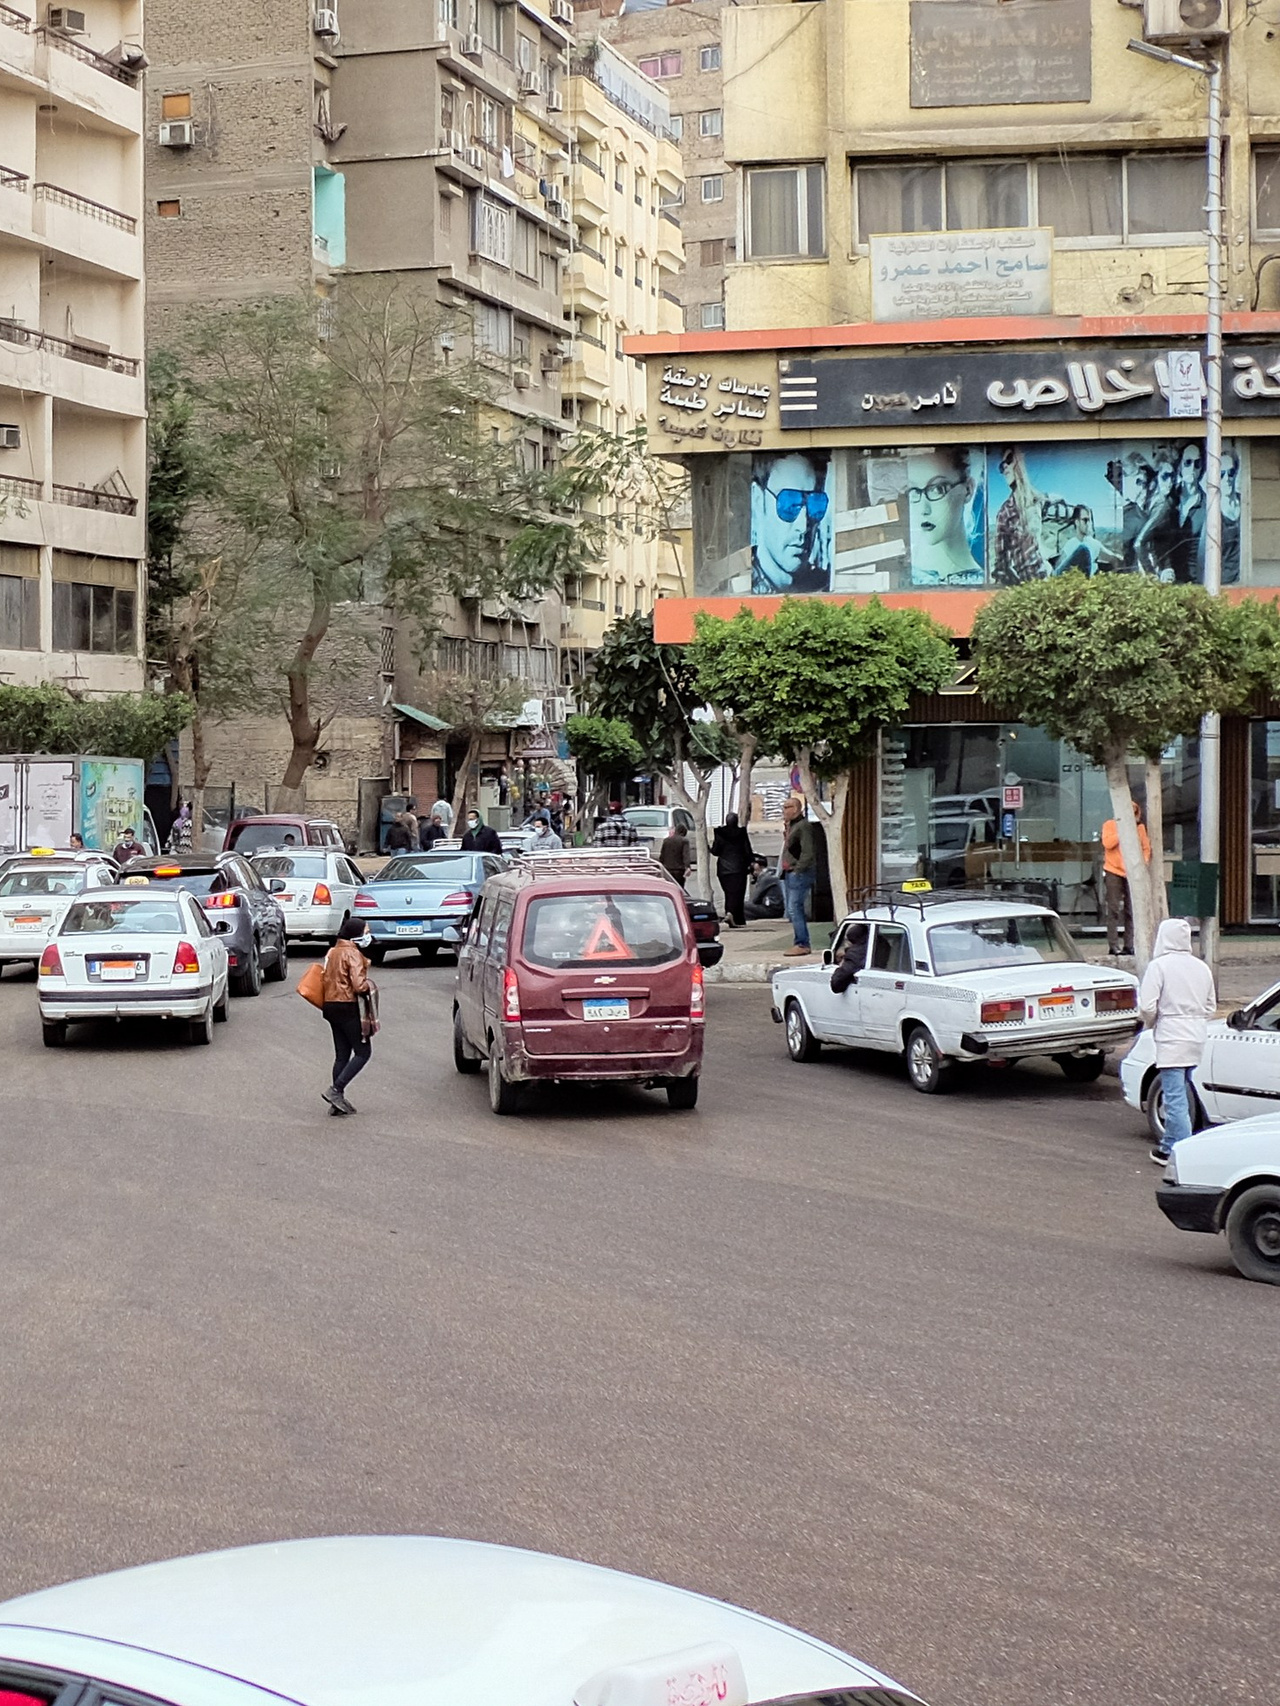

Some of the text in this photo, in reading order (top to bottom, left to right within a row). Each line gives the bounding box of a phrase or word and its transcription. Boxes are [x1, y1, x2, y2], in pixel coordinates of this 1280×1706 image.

[998, 236, 1036, 249] مكتب
[880, 264, 931, 281] عمرو
[996, 254, 1048, 277] سامح
[662, 364, 771, 403] عدسات لاصقة
[659, 385, 708, 414] طبية
